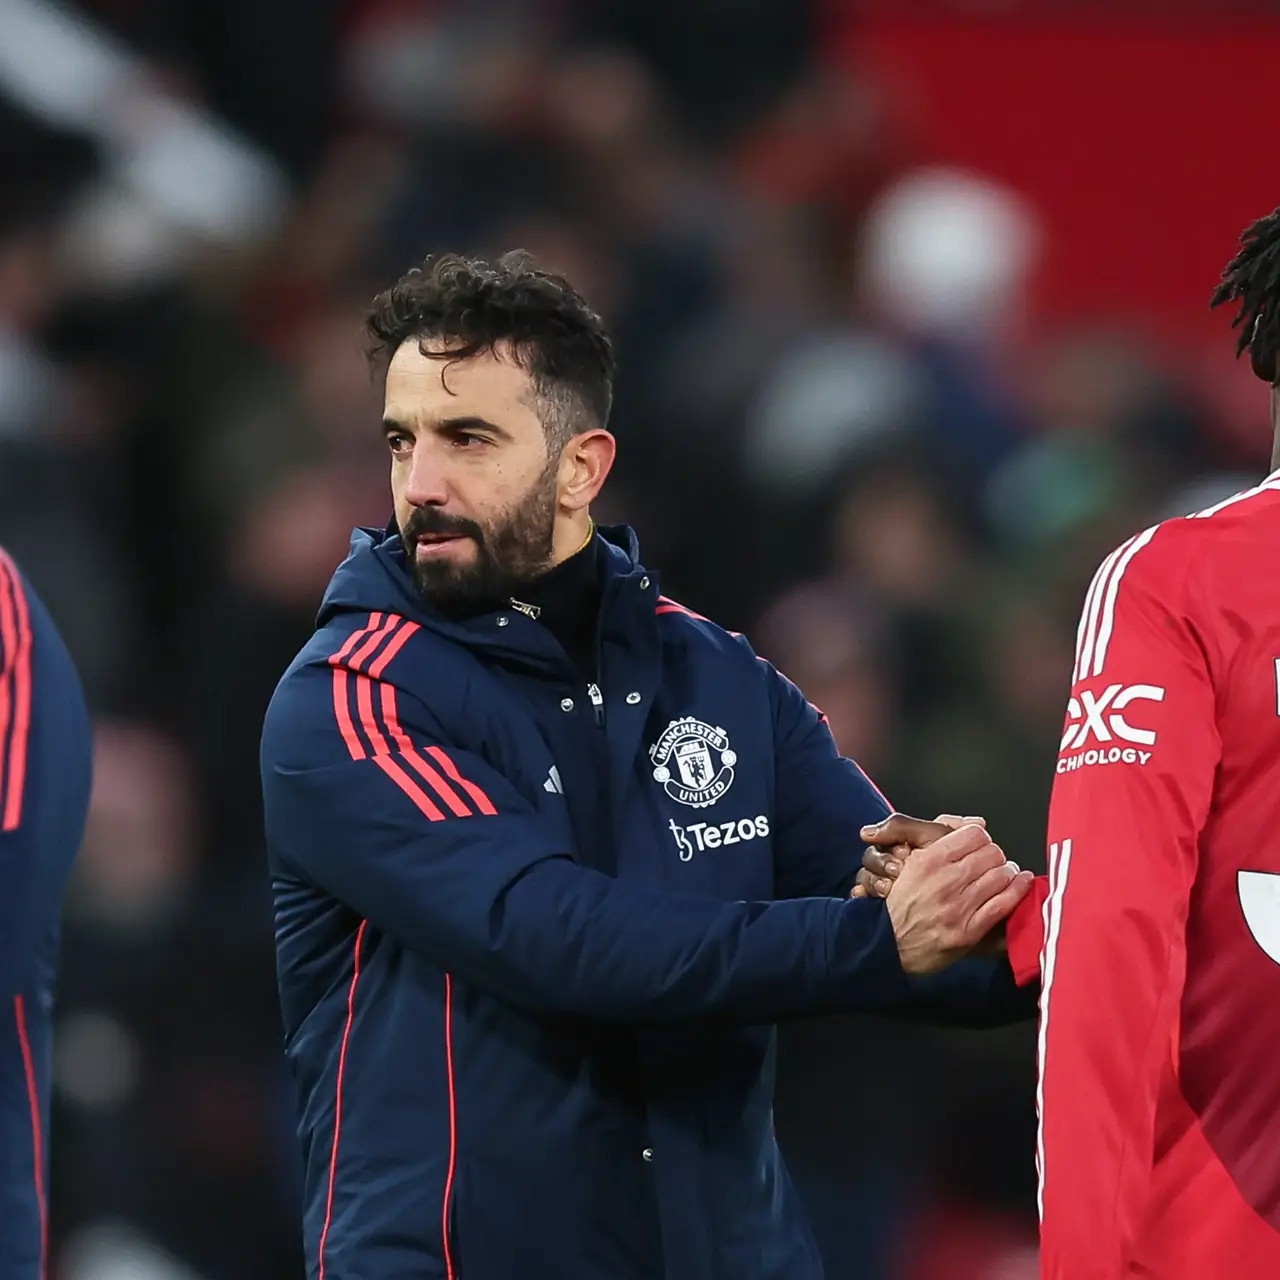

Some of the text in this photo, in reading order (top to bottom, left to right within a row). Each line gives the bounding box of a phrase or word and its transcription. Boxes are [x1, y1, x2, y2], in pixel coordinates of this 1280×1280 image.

[657, 723, 722, 760] MANCHESTER
[679, 781, 725, 802] UNITED
[687, 815, 770, 852] Tezos
